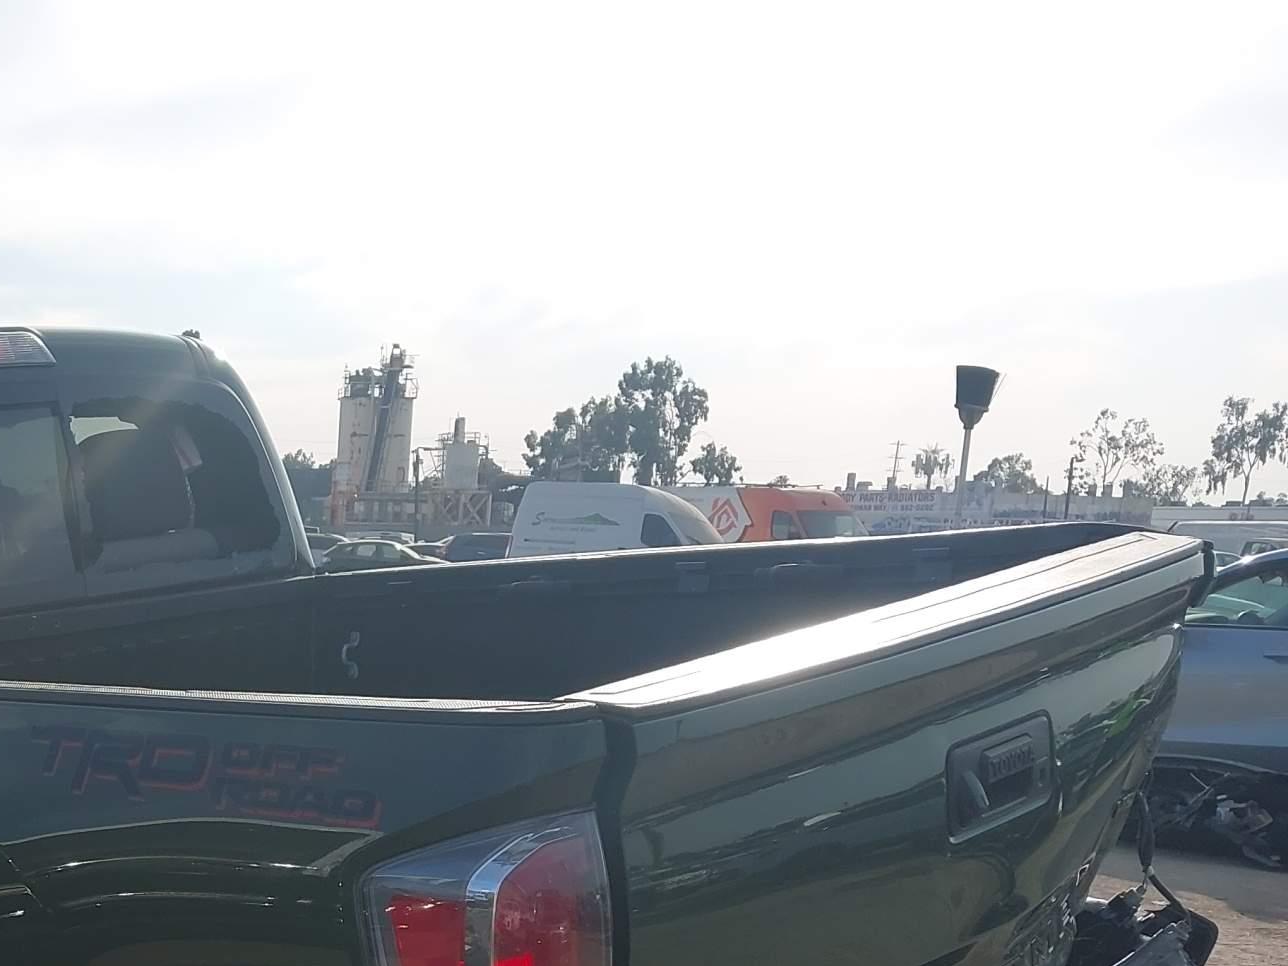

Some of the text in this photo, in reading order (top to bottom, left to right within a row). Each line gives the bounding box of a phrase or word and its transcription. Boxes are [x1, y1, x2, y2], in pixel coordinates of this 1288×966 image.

[31, 724, 346, 801] TRD OFF
[987, 745, 1033, 782] TOYOT
[213, 777, 382, 829] ROAD
